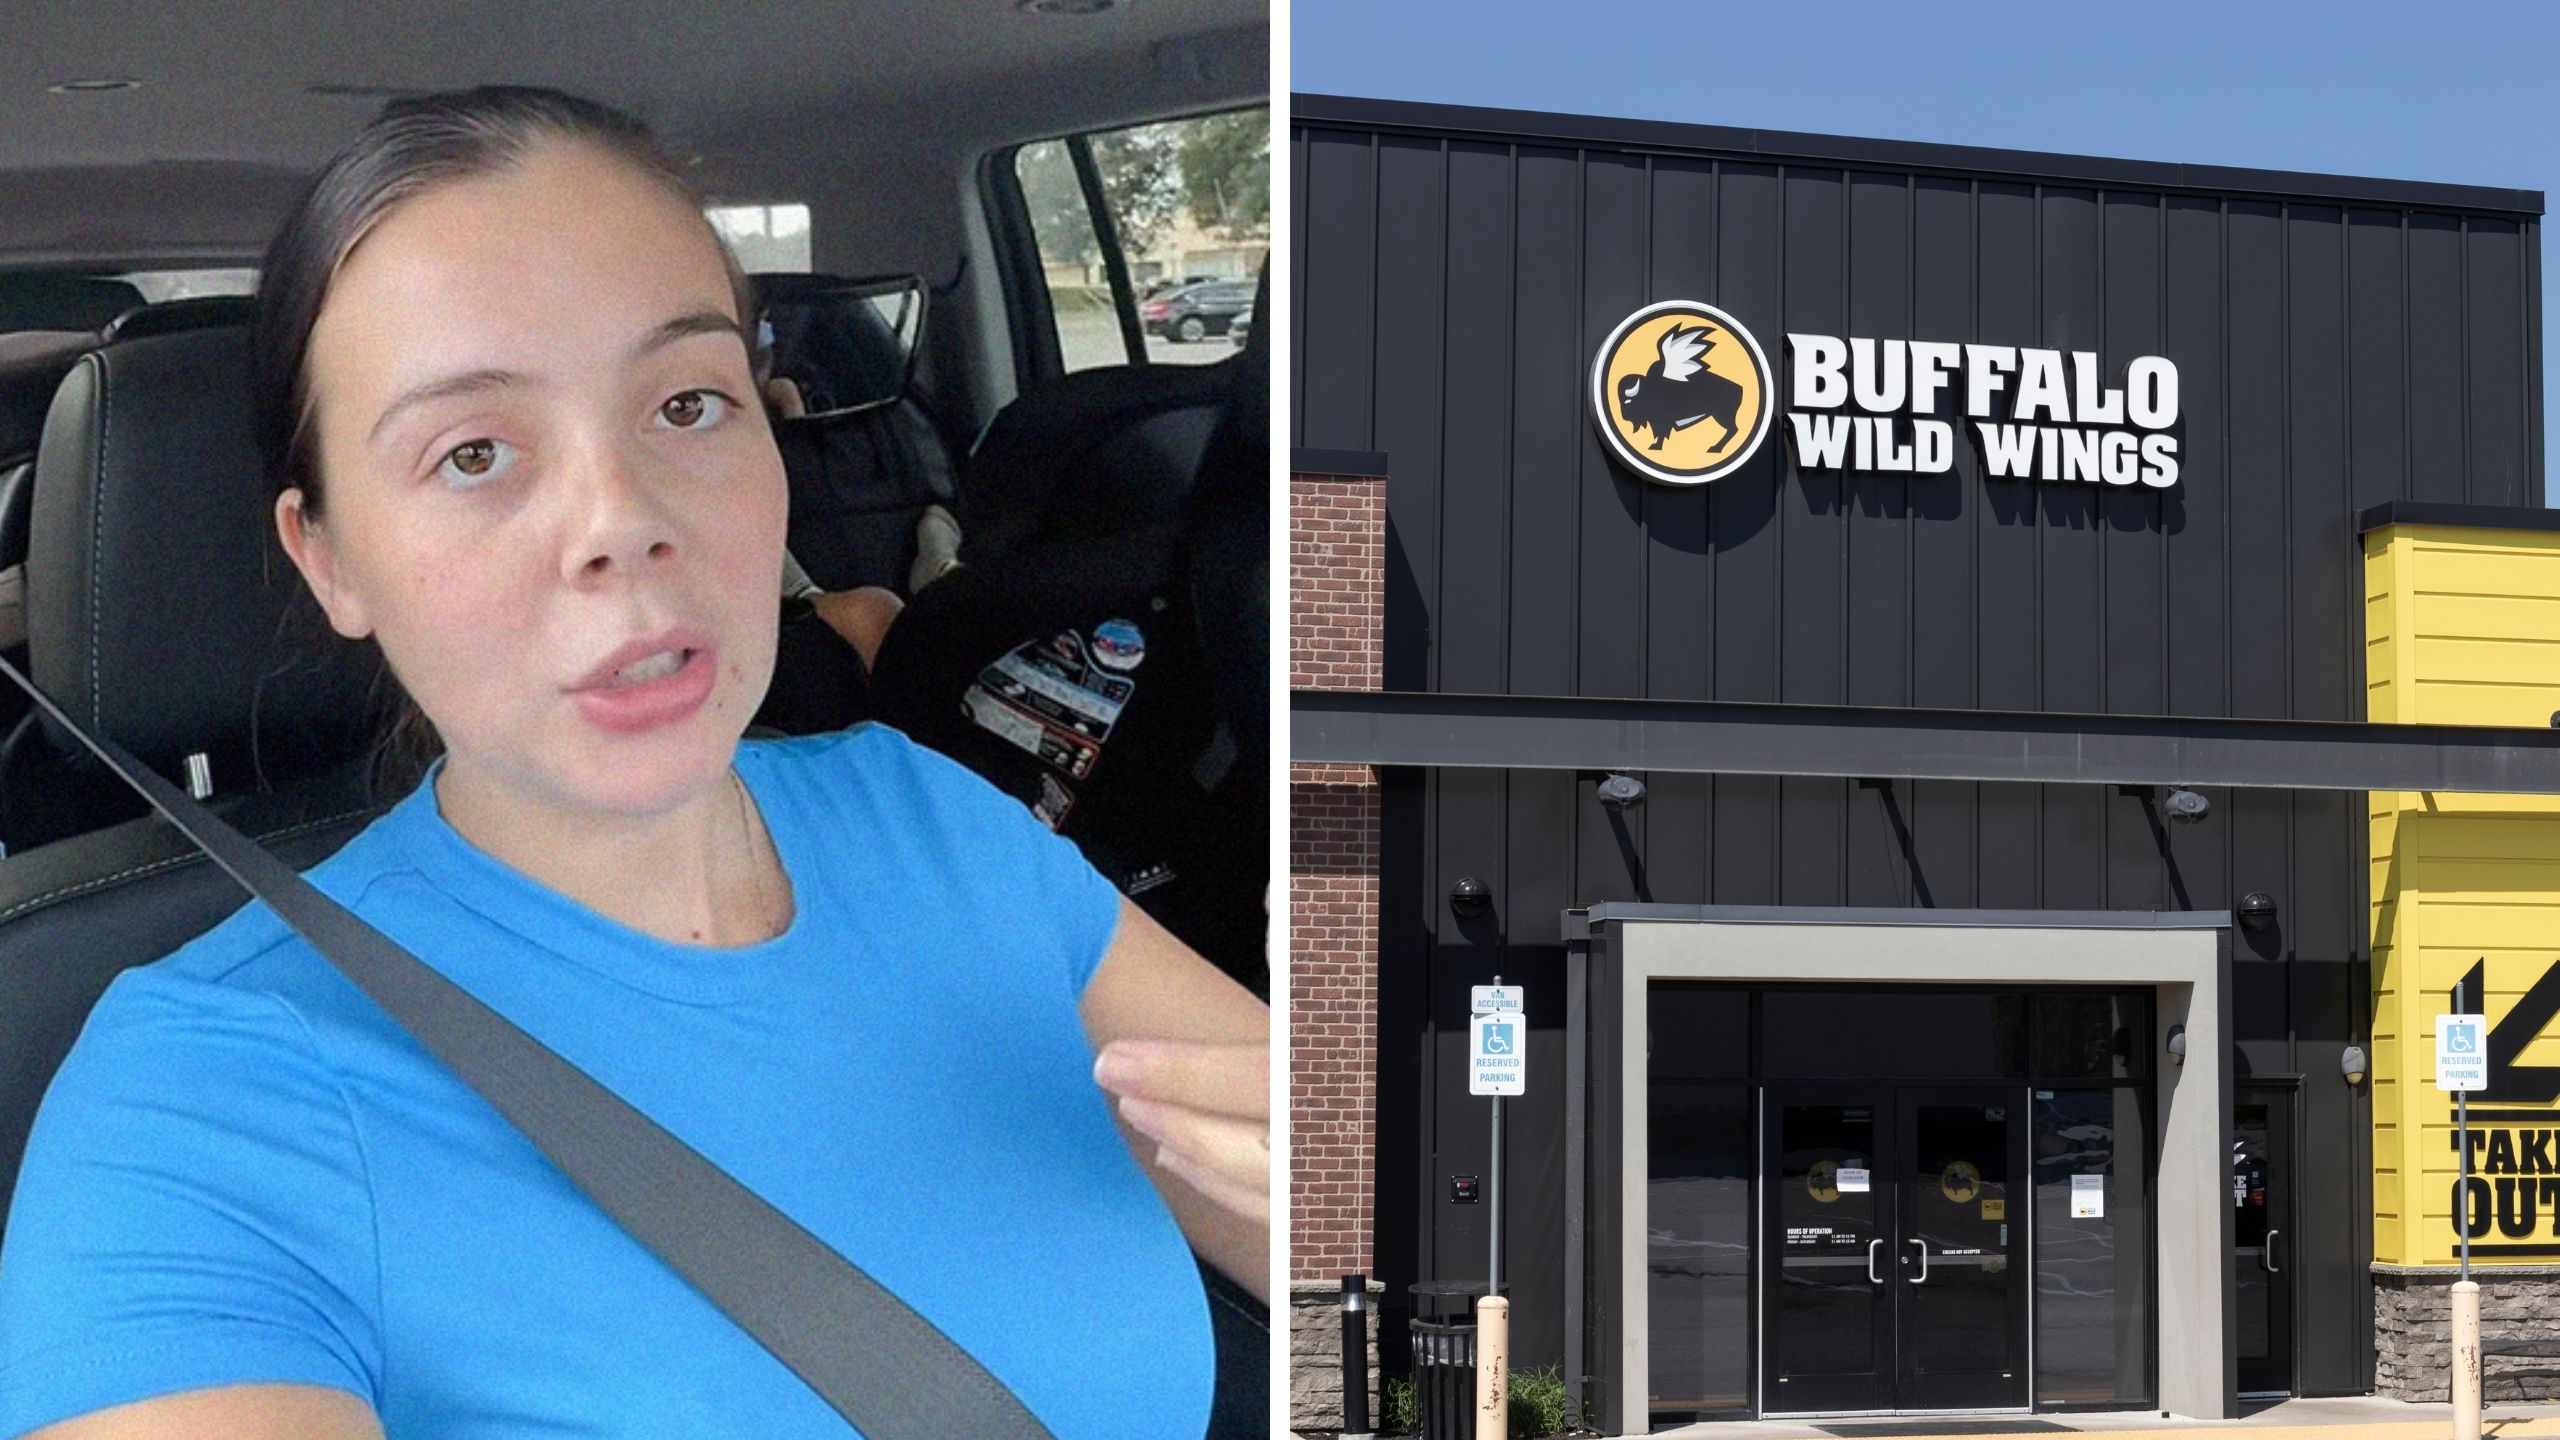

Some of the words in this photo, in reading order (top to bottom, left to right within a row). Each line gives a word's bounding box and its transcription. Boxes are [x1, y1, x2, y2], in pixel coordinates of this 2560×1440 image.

[1786, 333, 2179, 429] BUFFALO
[1787, 413, 1954, 474] WILD
[1976, 423, 2179, 488] WINGS
[1477, 1000, 1518, 1008] ACCESSIBLE
[1476, 1058, 1519, 1067] RESERVED
[2441, 1056, 2482, 1065] RESERVED
[1480, 1073, 1515, 1082] PARKING
[2445, 1070, 2479, 1079] PARKING
[2451, 1129, 2560, 1175] TAK
